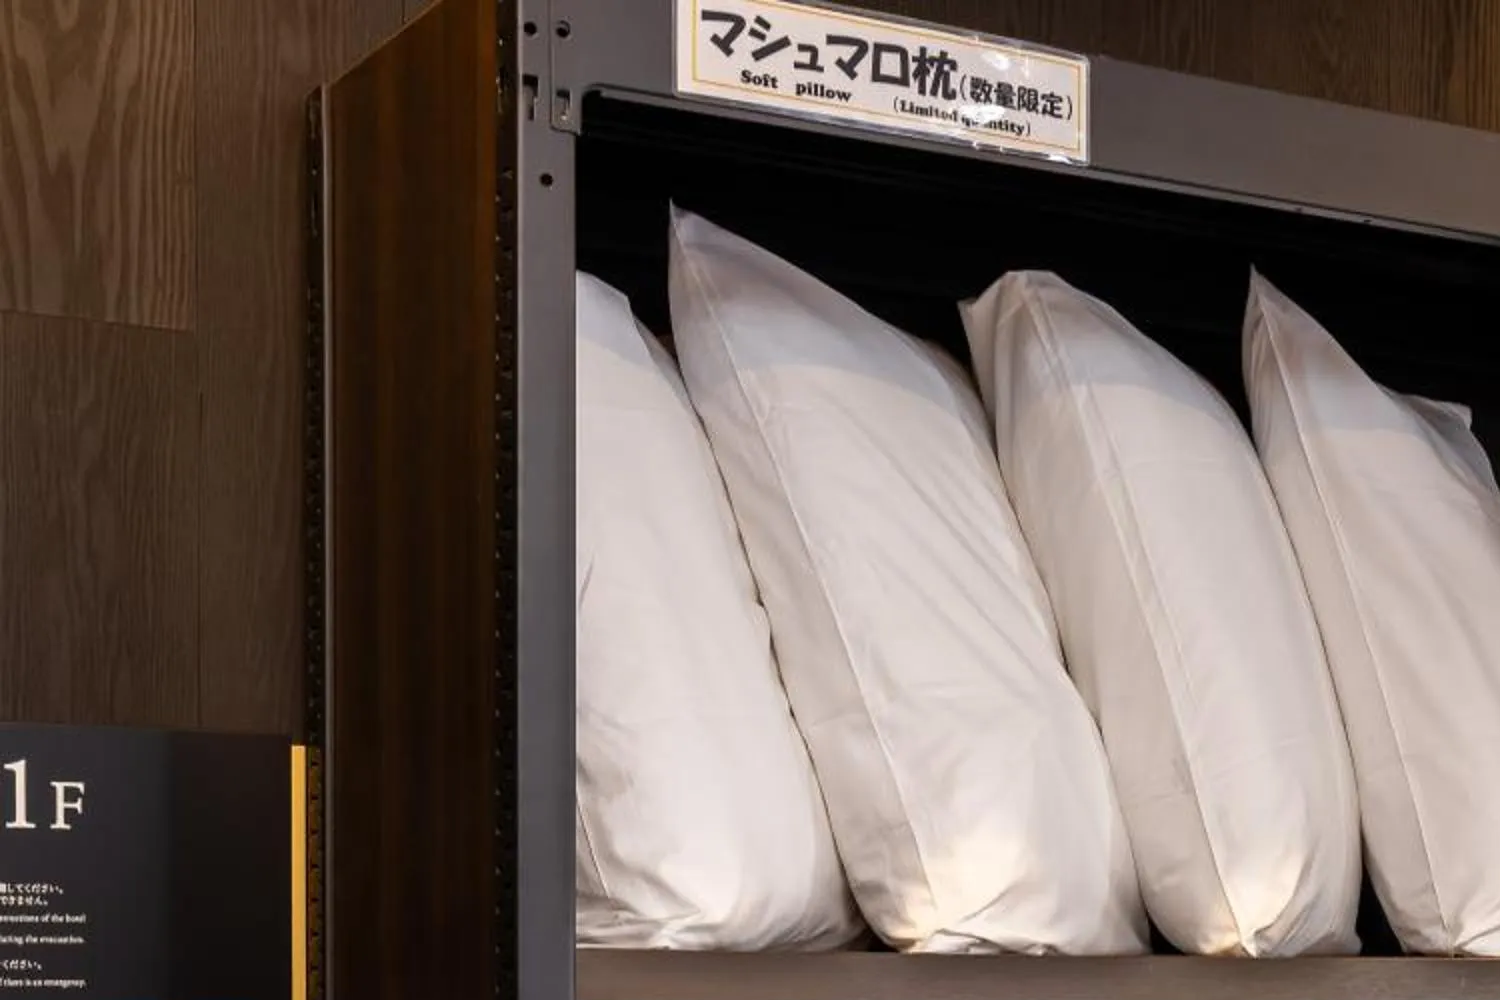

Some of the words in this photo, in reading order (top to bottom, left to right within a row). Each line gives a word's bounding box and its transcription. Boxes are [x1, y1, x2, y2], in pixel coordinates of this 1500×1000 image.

[741, 70, 778, 89] Soft
[795, 82, 852, 102] pillow
[894, 96, 958, 122] (Limited
